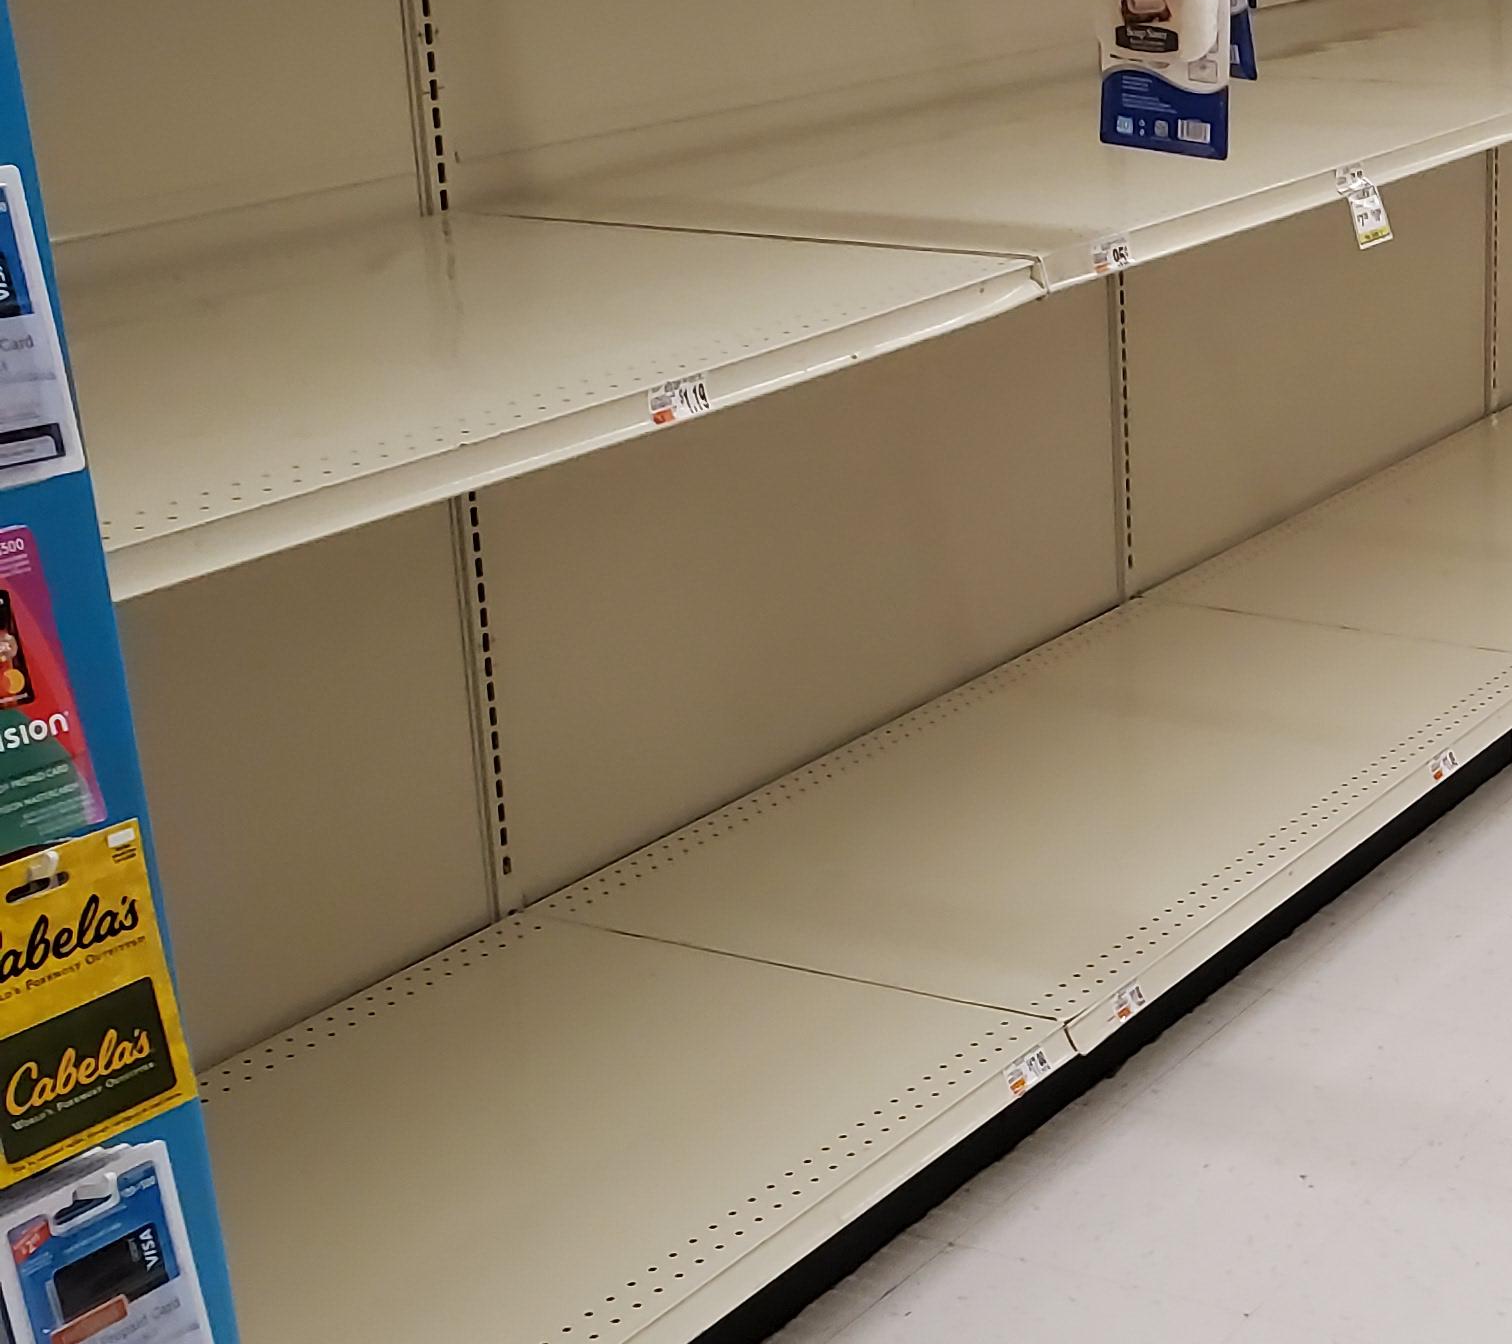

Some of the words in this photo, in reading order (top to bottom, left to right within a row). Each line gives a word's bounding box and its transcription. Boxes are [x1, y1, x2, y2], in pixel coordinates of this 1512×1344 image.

[1, 335, 34, 352] Card
[0, 894, 139, 984] abela's
[6, 1029, 150, 1115] Cabela's
[141, 1228, 159, 1272] VISA
